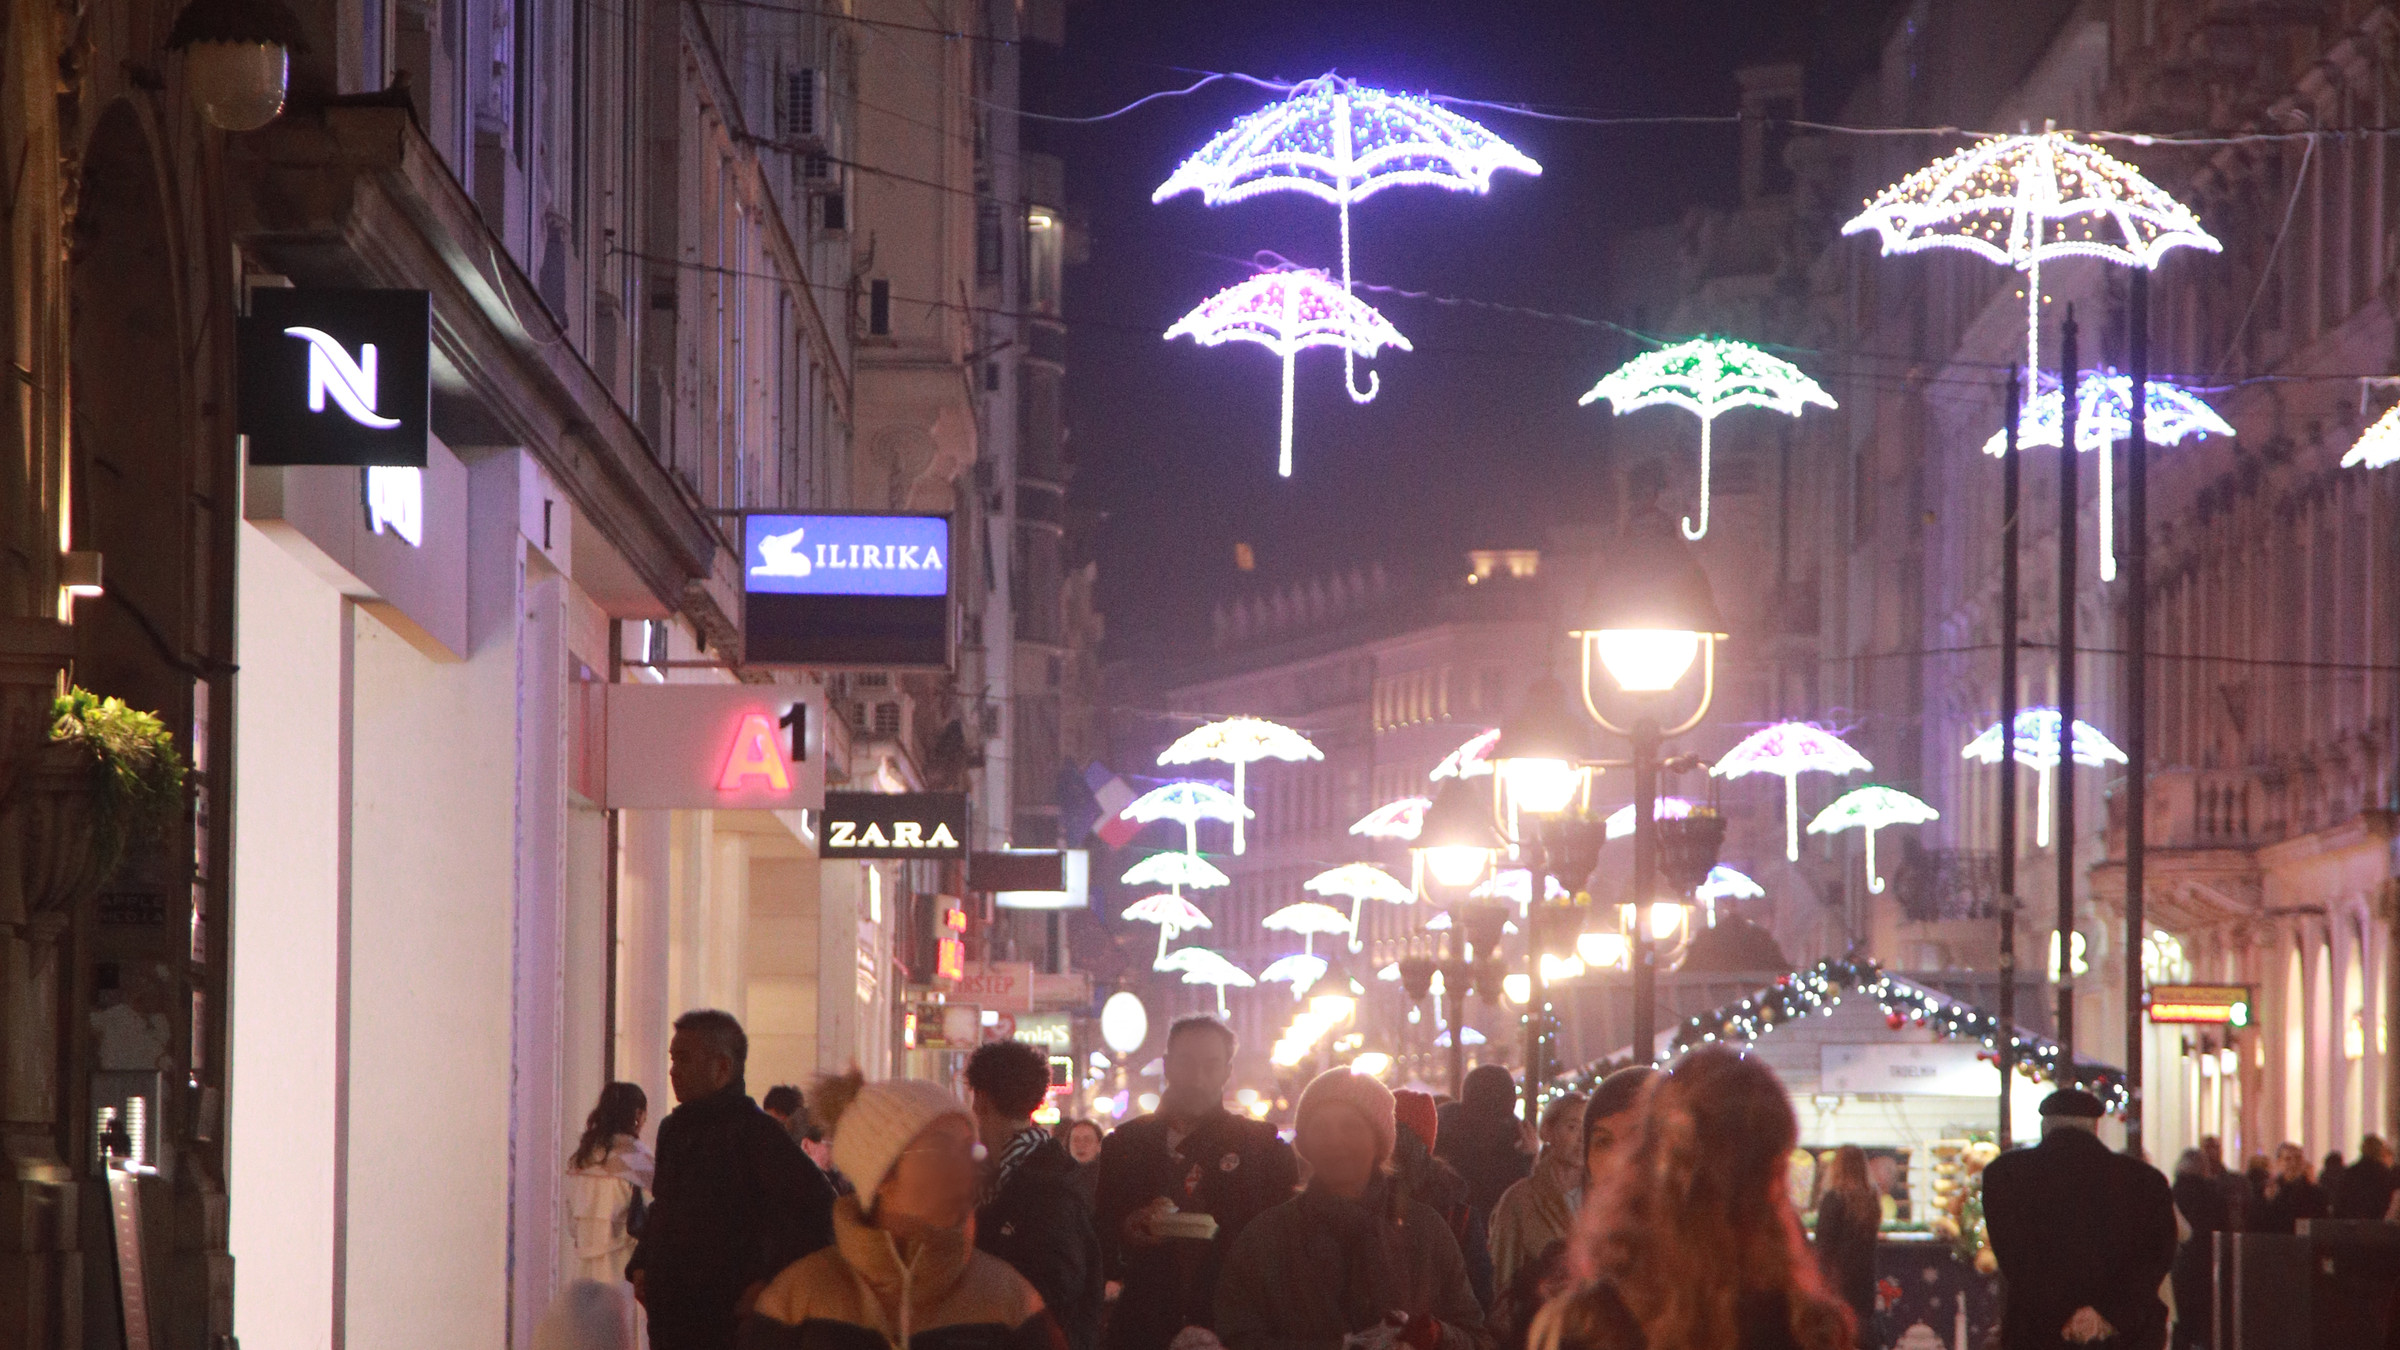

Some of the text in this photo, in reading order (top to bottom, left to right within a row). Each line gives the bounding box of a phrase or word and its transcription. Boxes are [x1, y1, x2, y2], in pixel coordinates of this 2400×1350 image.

[284, 326, 401, 429] N
[815, 544, 943, 569] ILIRIKA
[716, 702, 808, 790] A1
[829, 821, 959, 848] ZARA
